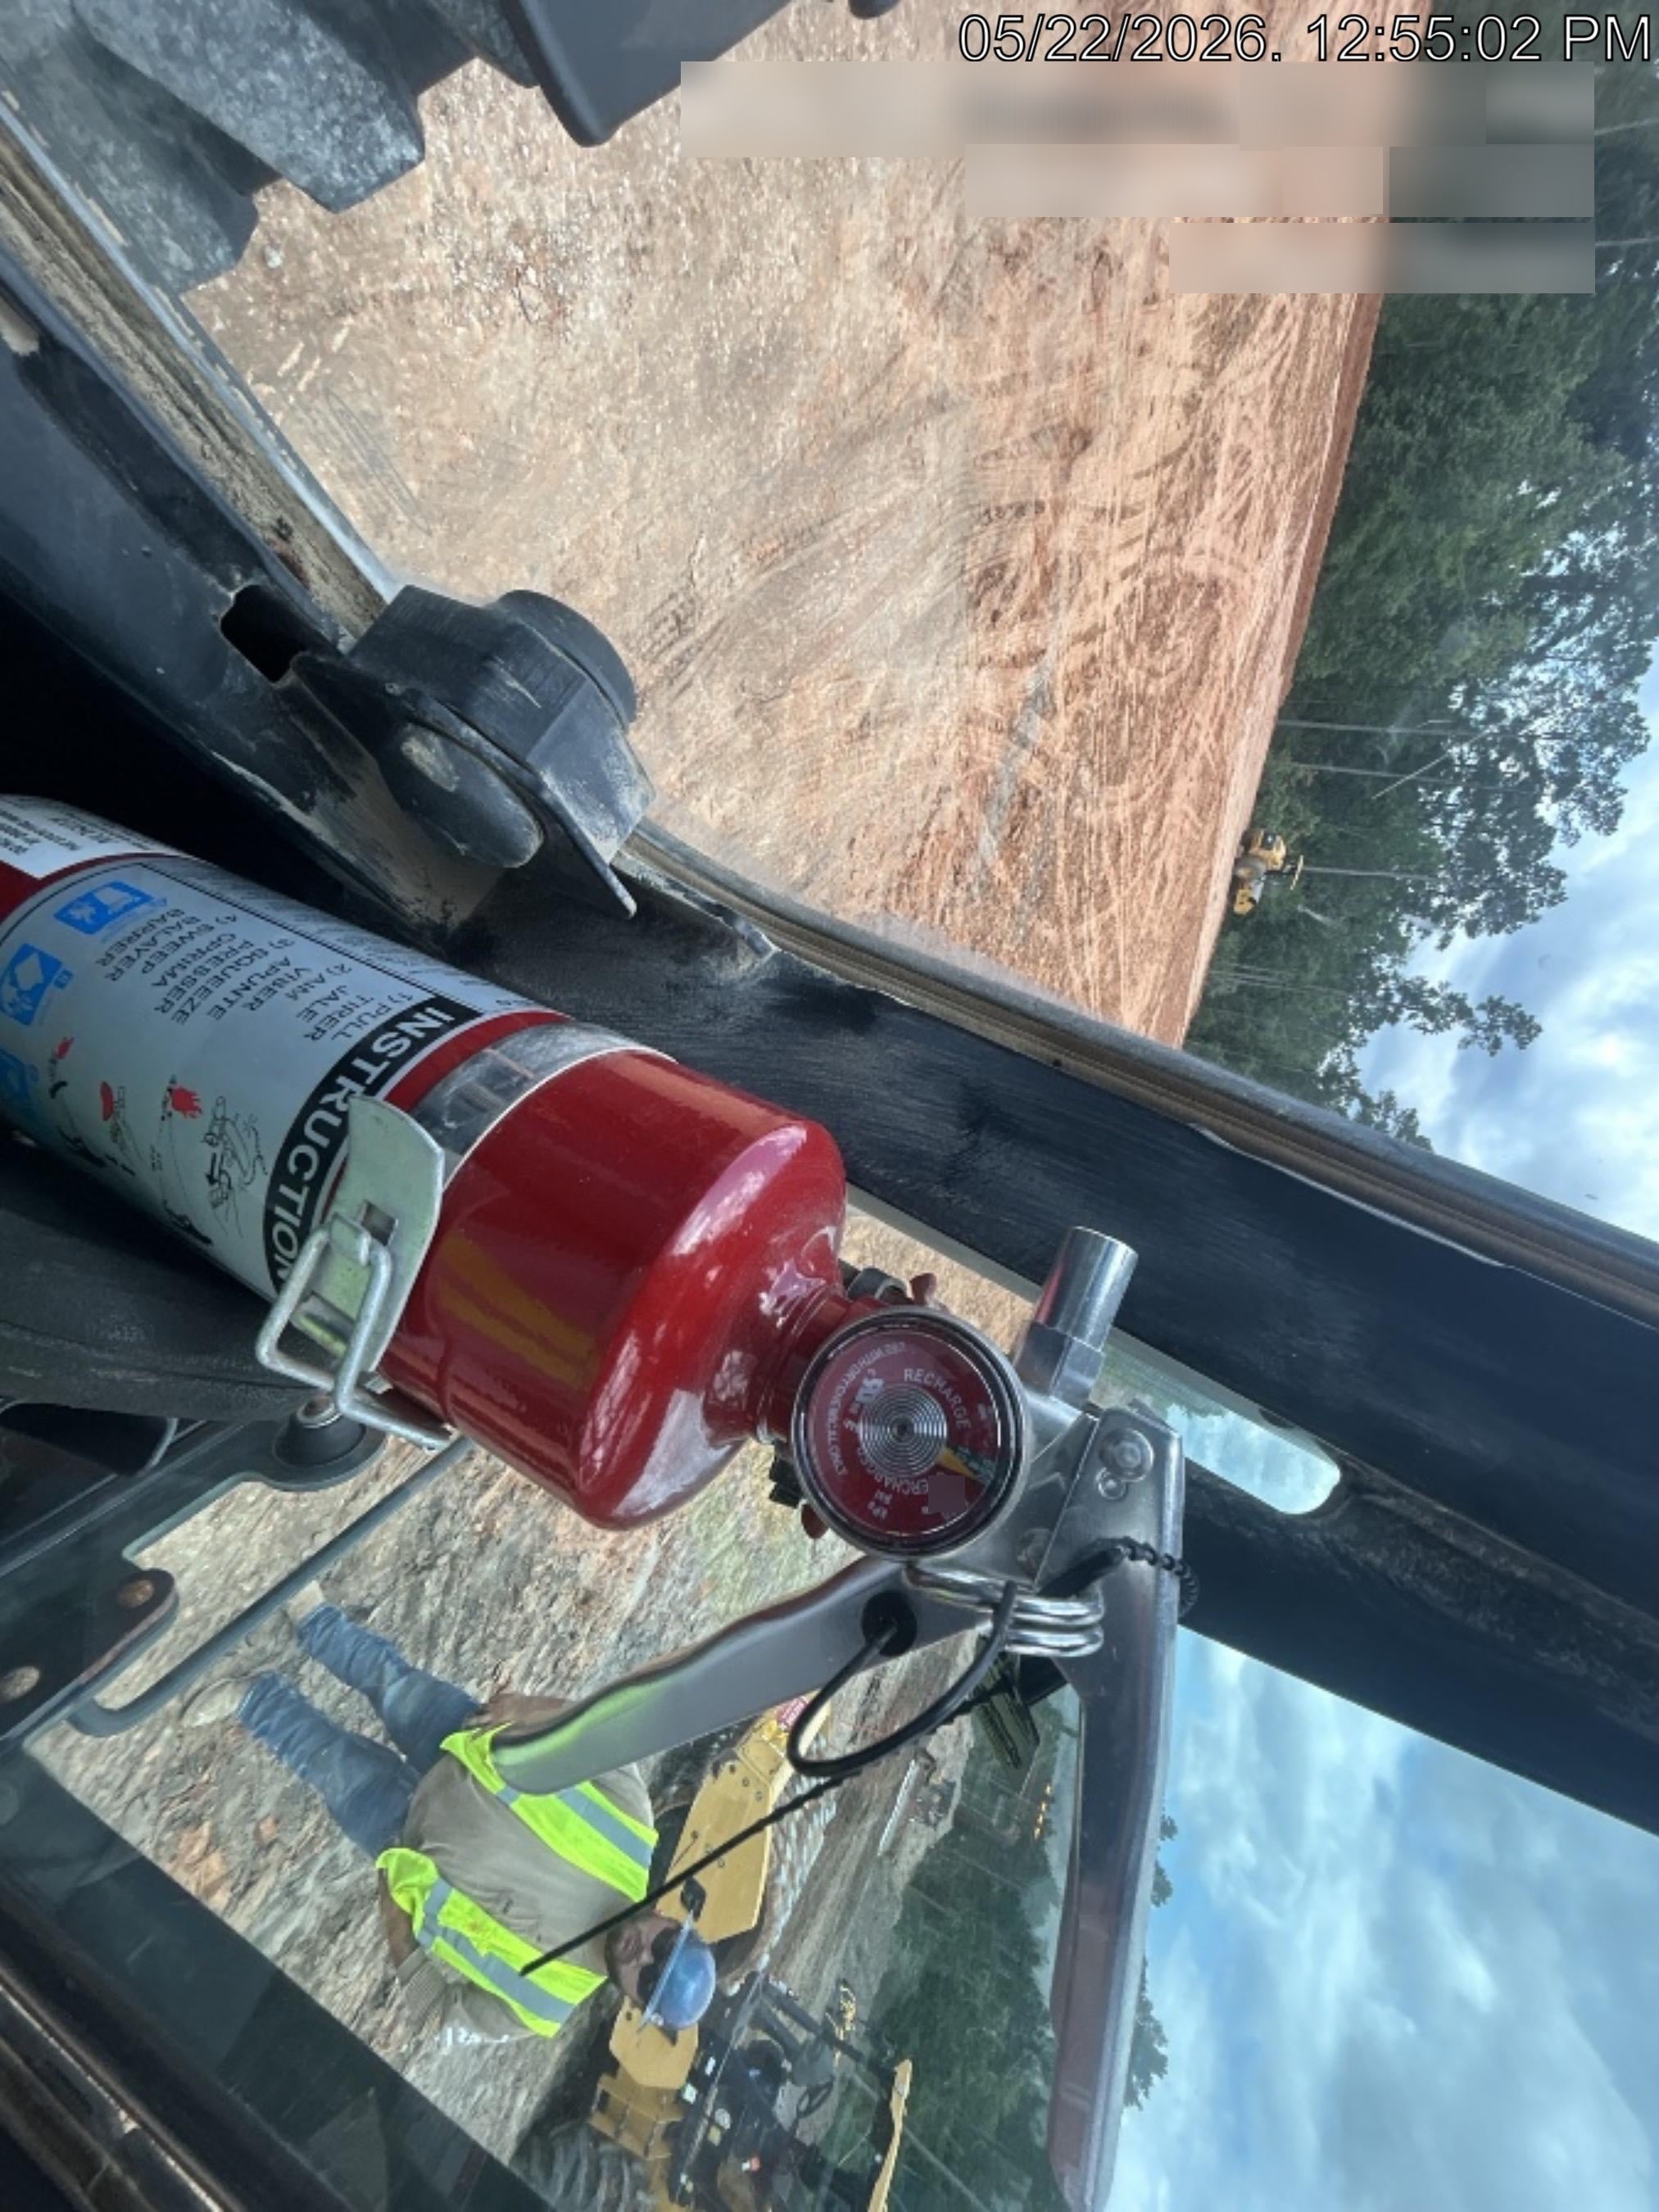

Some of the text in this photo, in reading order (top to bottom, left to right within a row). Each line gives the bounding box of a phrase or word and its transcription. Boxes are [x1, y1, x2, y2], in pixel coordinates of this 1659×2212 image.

[104, 916, 201, 981] BALAYER
[141, 924, 215, 974] SWEEP
[152, 933, 237, 987] OPRIMA
[170, 948, 268, 1025] SQUEEZE
[207, 957, 292, 1021] APUNTE
[285, 963, 351, 1001] 2) AIM
[297, 985, 348, 1022] JALE
[302, 995, 374, 1041] TIRER
[331, 1004, 392, 1041] PULL
[904, 1367, 972, 1430] RECHARGE
